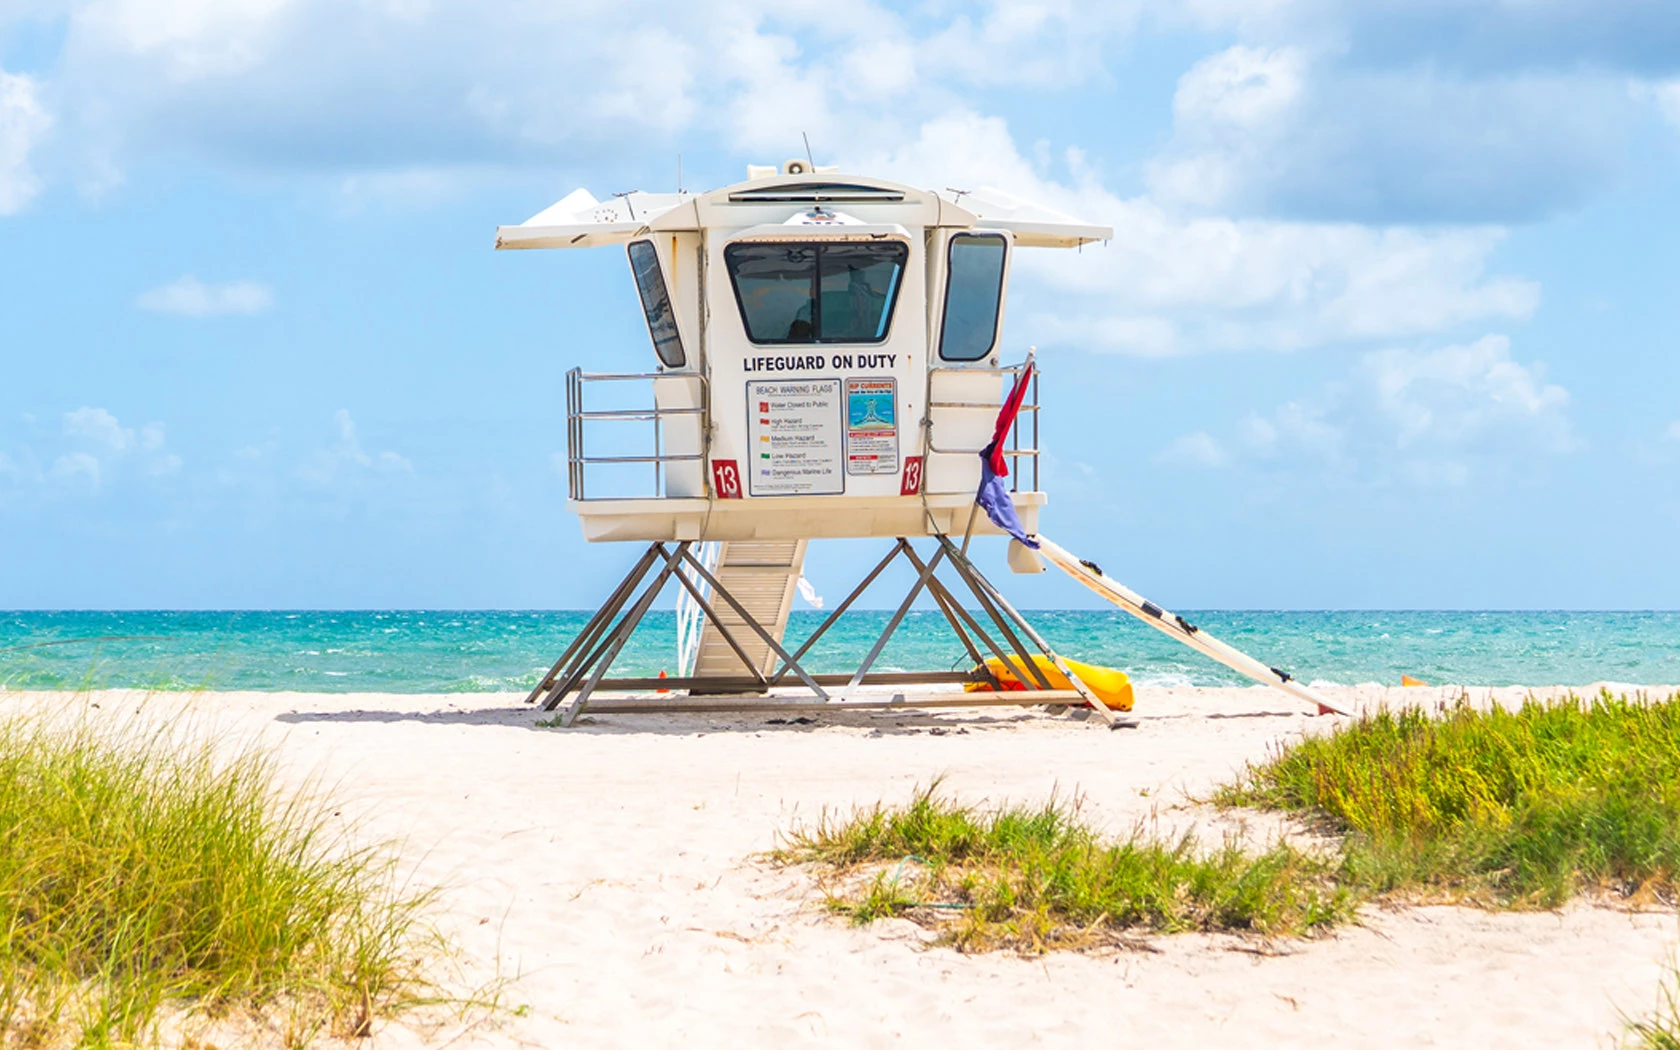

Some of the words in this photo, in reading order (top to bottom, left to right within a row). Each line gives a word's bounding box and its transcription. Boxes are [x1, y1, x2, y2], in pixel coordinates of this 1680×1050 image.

[743, 356, 825, 371] LIFEGUARD
[831, 355, 852, 369] ON
[858, 354, 897, 368] DUTY
[756, 386, 778, 394] BEACH
[780, 385, 810, 393] WARNING
[812, 384, 833, 393] FLAGS
[716, 466, 738, 494] 13
[772, 469, 802, 477] Dangerous
[905, 462, 920, 490] 13
